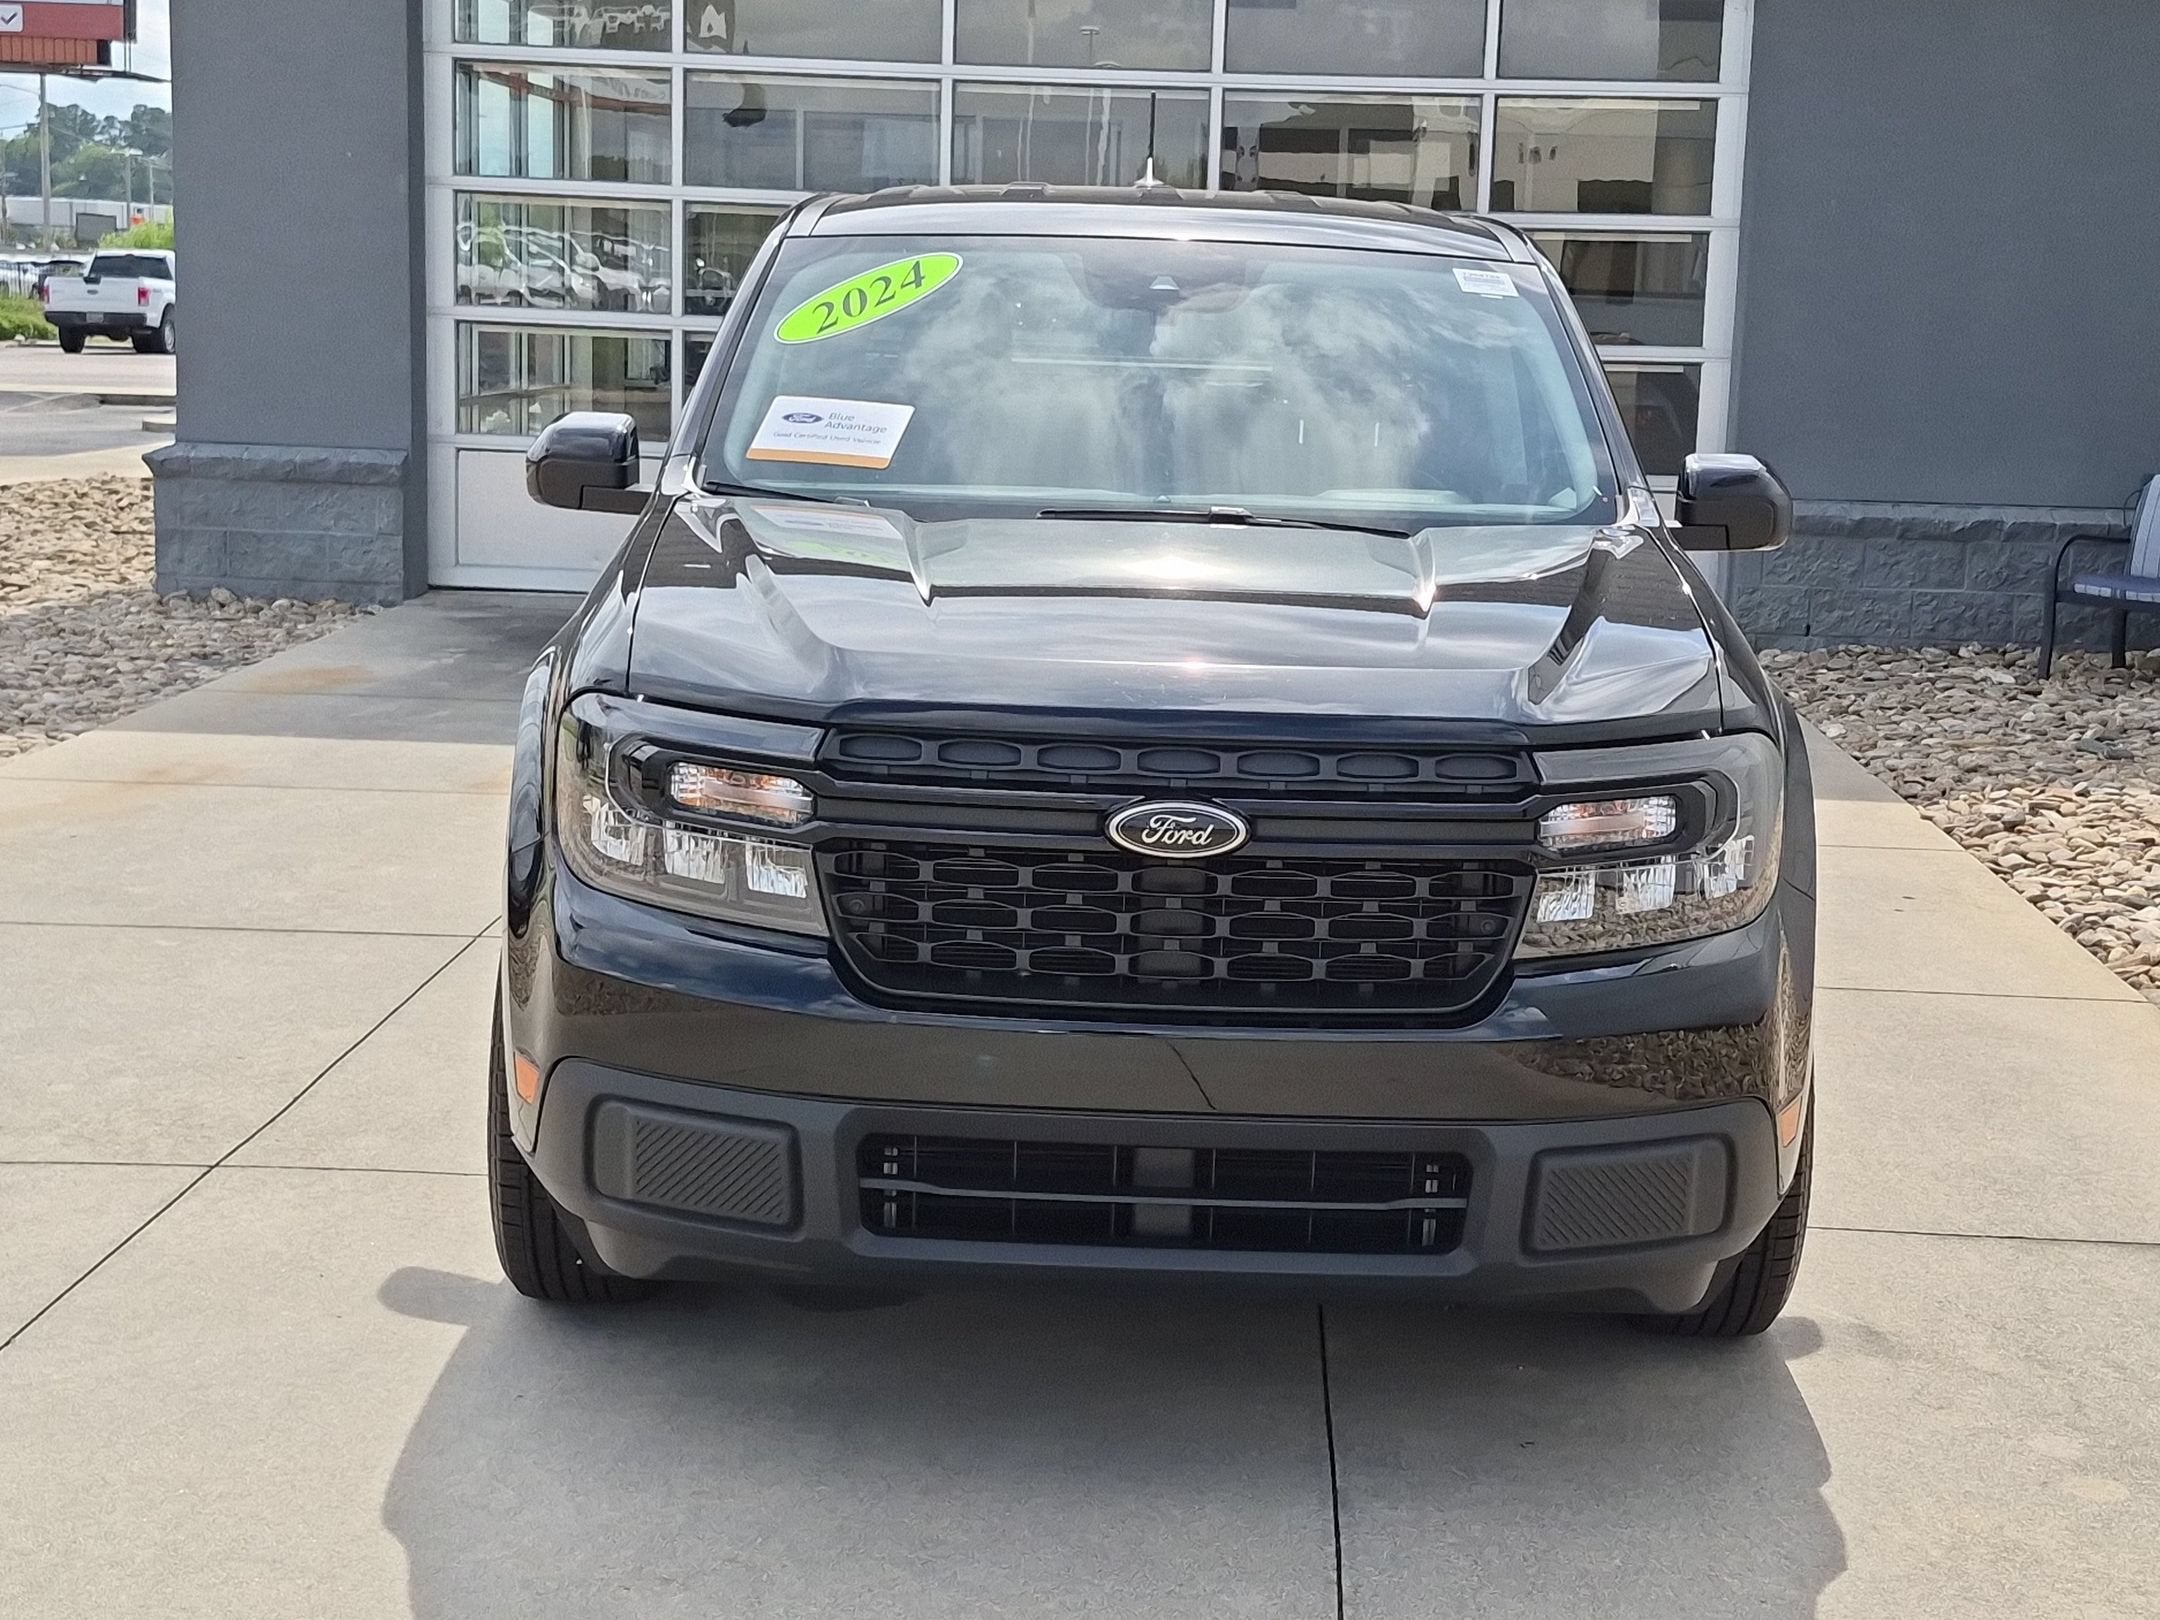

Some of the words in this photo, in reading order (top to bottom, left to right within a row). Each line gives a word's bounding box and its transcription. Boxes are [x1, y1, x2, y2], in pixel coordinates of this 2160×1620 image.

[812, 260, 926, 335] 2024
[824, 422, 888, 434] Advantage
[828, 412, 856, 422] Blue
[1141, 814, 1215, 846] Ford
